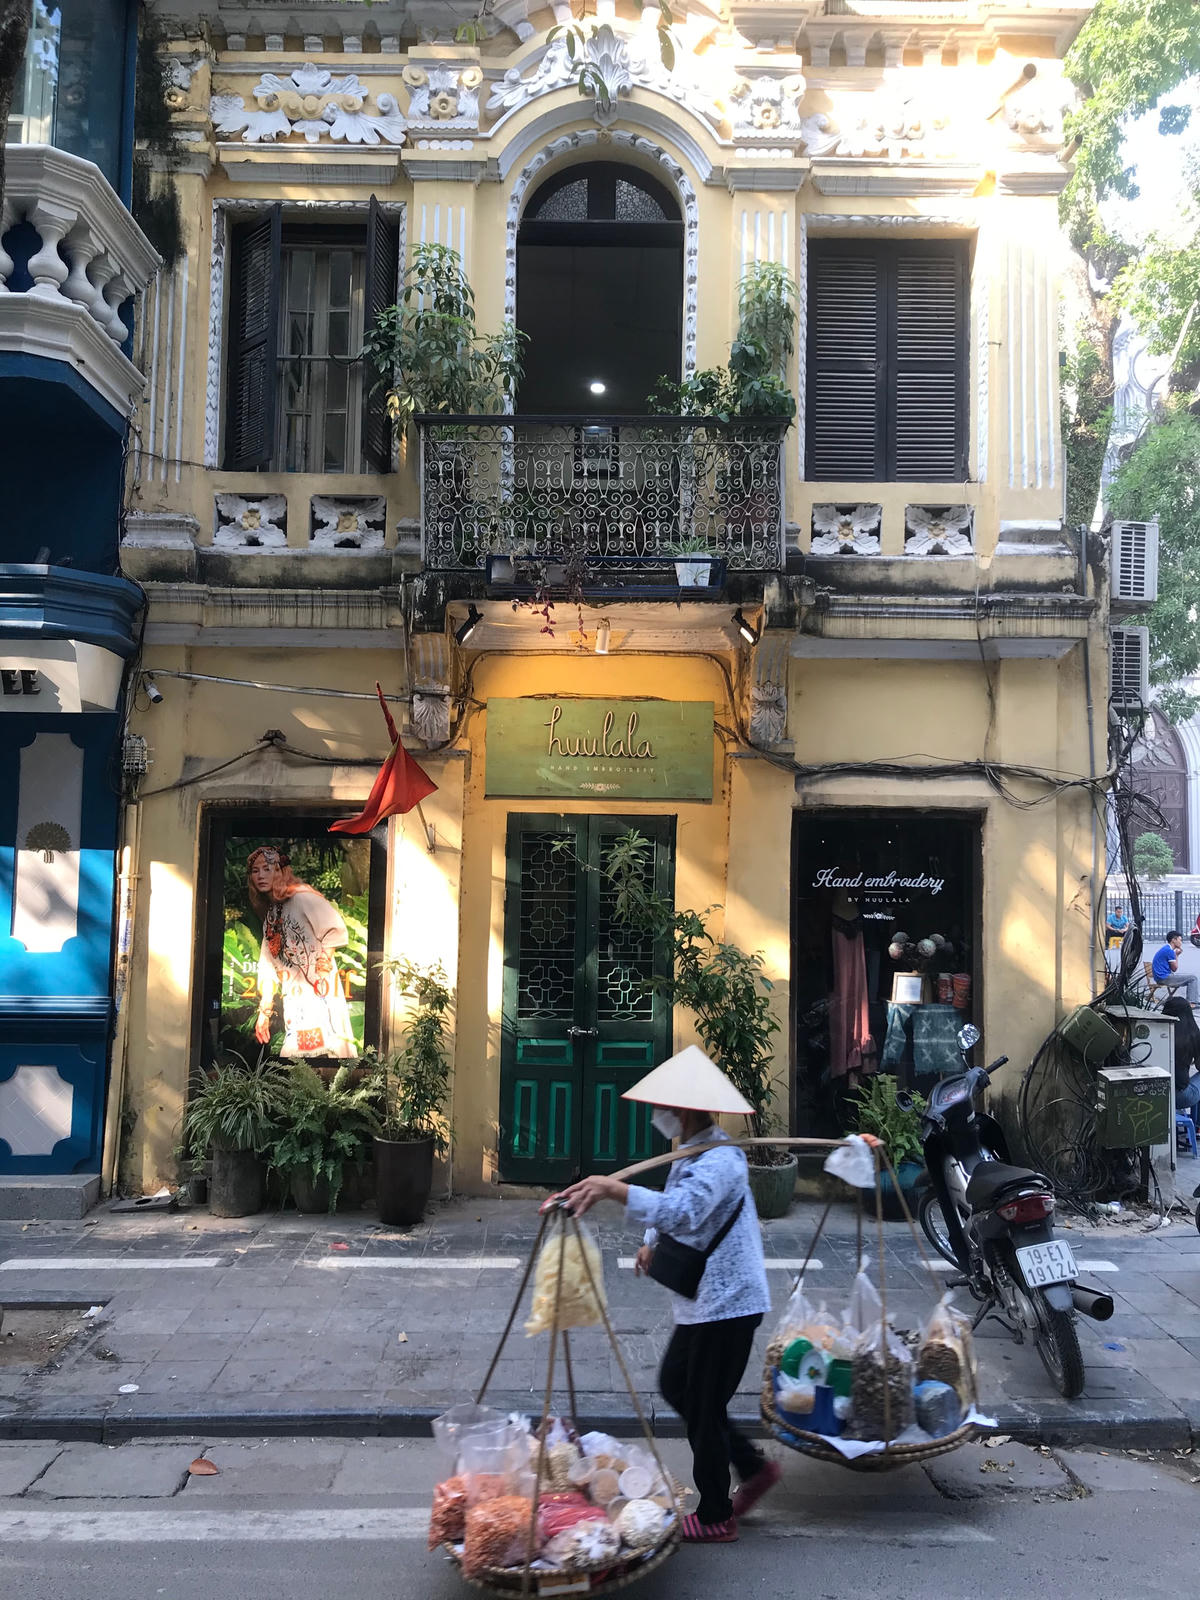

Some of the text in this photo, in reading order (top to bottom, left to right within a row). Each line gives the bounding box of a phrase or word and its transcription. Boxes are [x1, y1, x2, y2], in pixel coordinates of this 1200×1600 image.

[544, 705, 656, 758] huulala
[812, 866, 864, 888] Hand
[1027, 1244, 1065, 1266] 19-E1
[1028, 1261, 1076, 1285] 191.24
